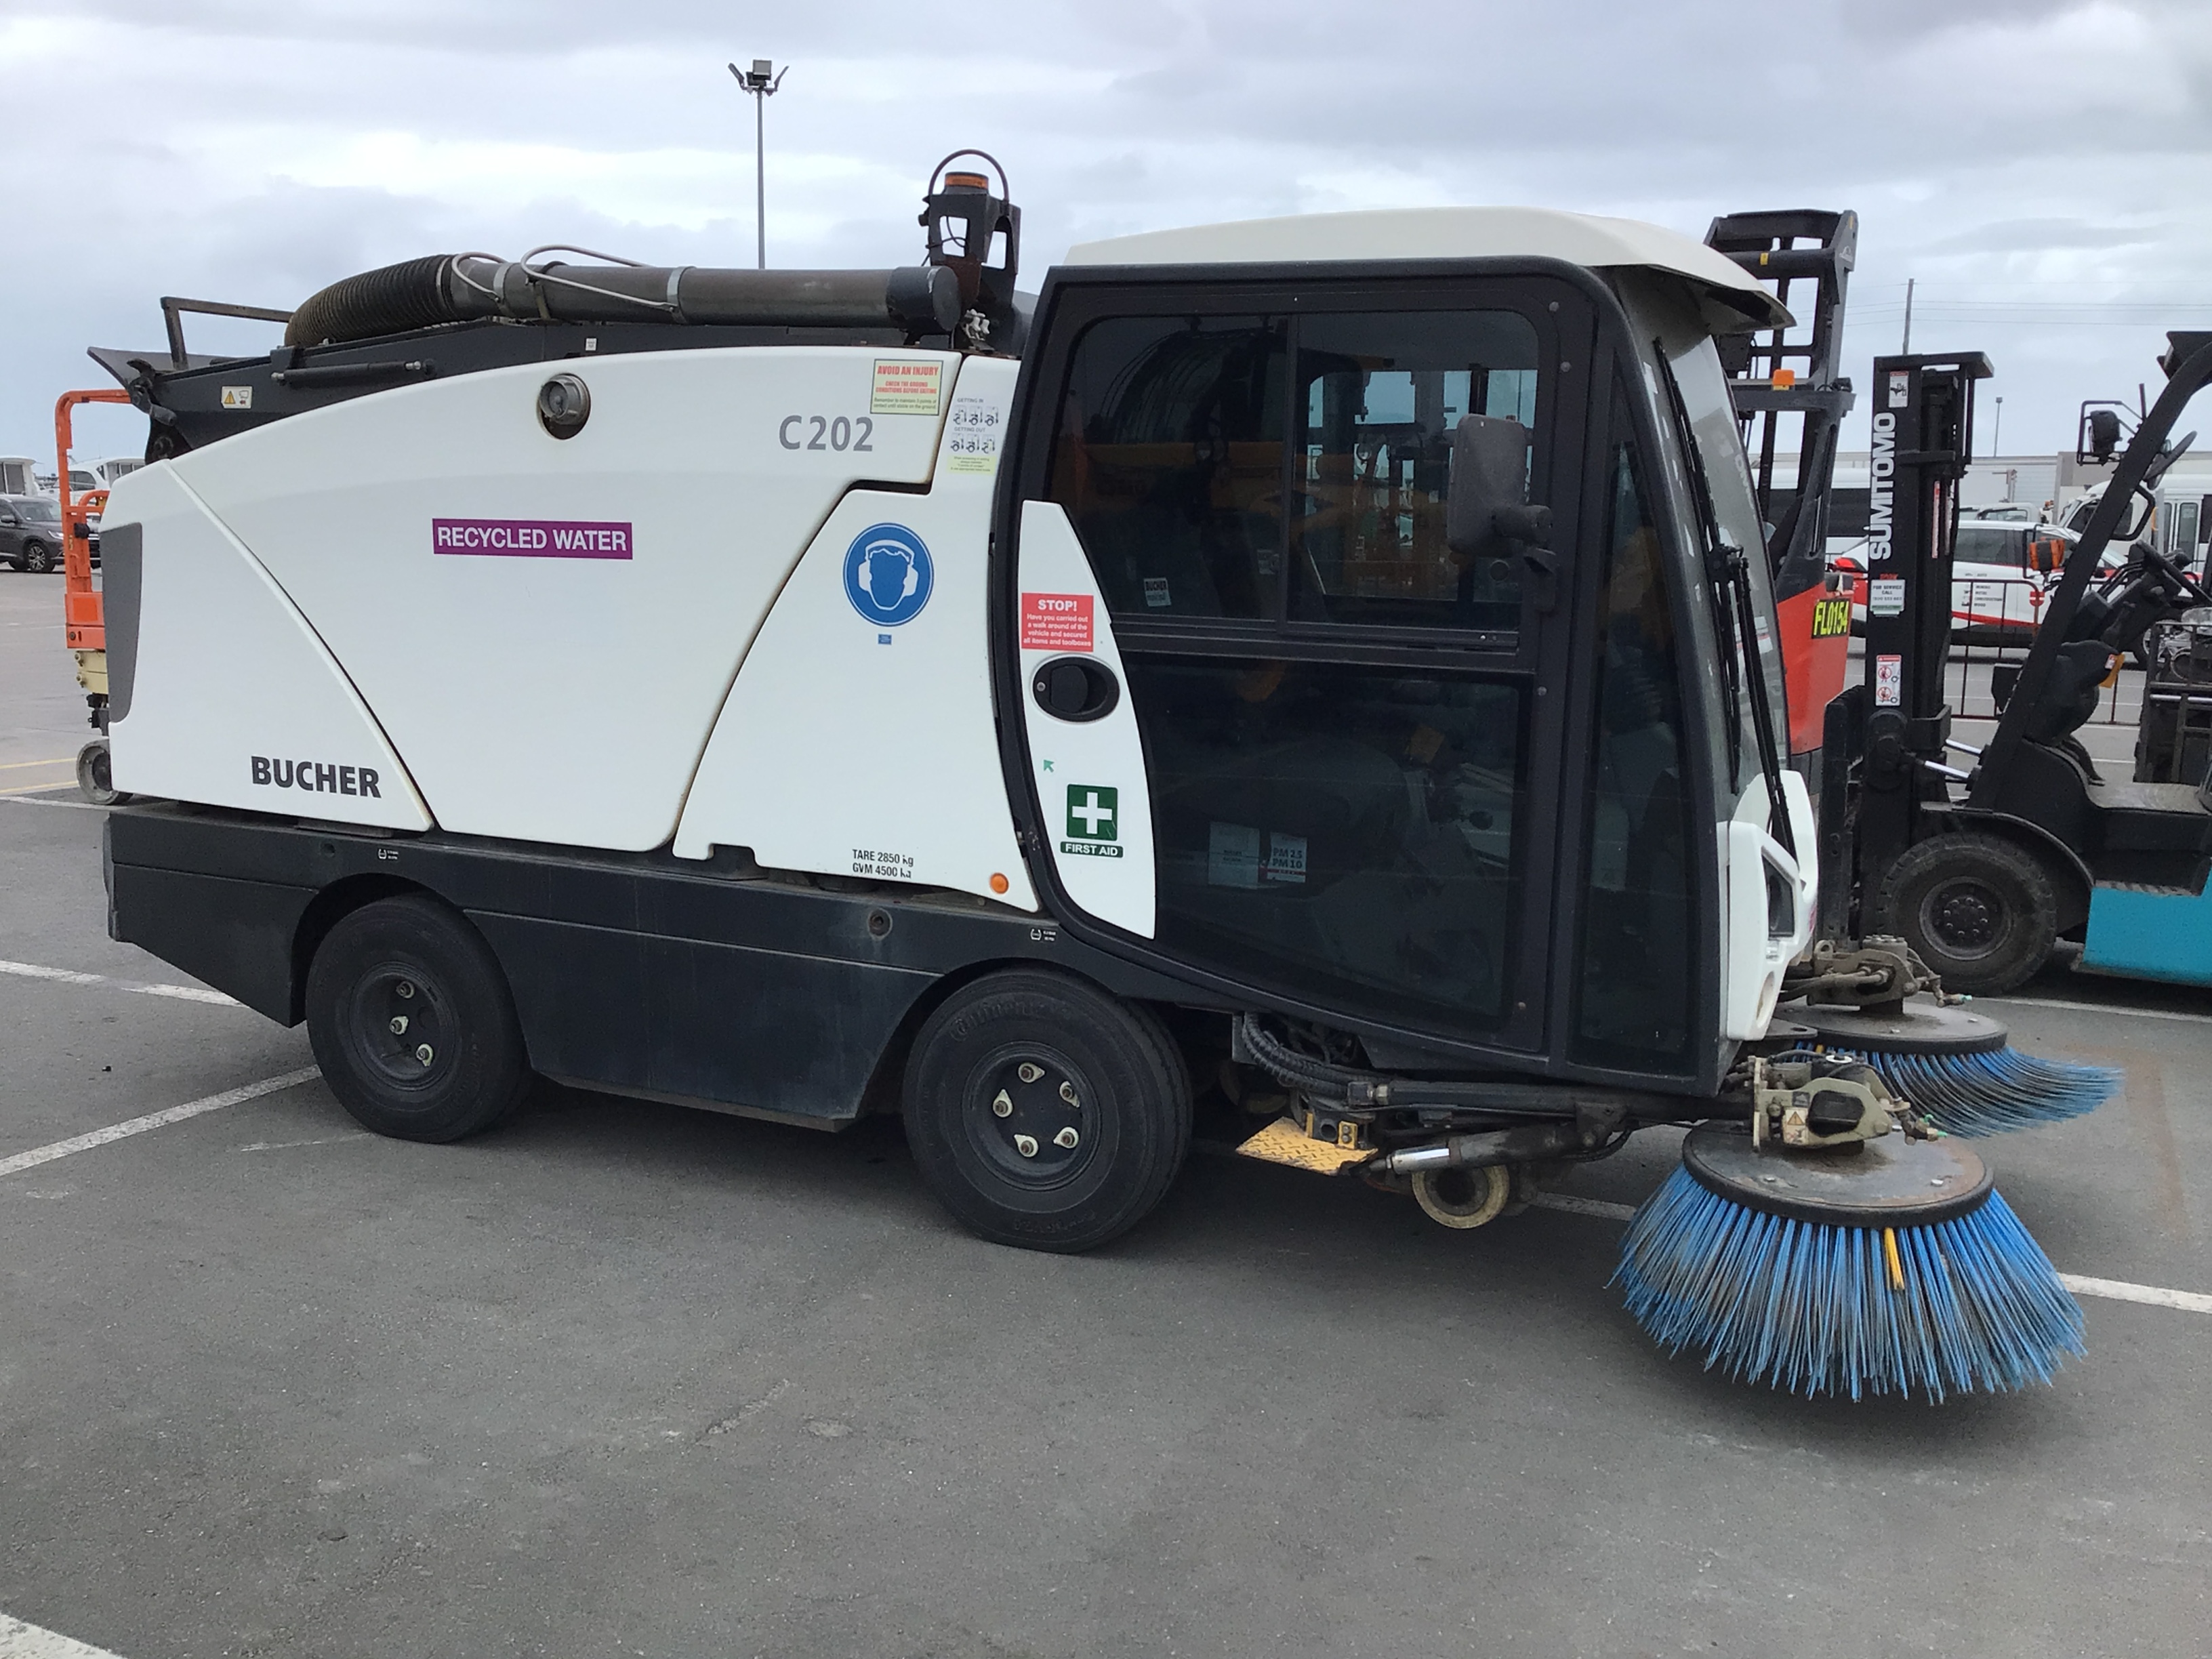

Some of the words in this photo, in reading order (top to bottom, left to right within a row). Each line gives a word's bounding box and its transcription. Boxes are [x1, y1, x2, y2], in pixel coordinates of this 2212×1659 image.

[877, 365, 900, 375] AVOID
[901, 366, 912, 375] AN
[913, 367, 939, 376] INJURY
[779, 415, 873, 452] C202
[1869, 411, 1896, 560] SUMITOMO
[438, 527, 548, 549] RECYCLED
[552, 529, 627, 551] WATER
[1038, 599, 1078, 612] STOP!
[1813, 600, 1849, 636] FL0154
[251, 756, 382, 798] BUCHER
[852, 848, 875, 861] TARE
[877, 851, 900, 864] 2850
[1065, 843, 1097, 855] FIRST
[1099, 846, 1118, 856] AID
[1273, 847, 1289, 857] PM
[852, 862, 873, 874] GVM
[875, 865, 898, 877] 4500
[1272, 858, 1288, 867] PM
[1290, 860, 1303, 869] 10
